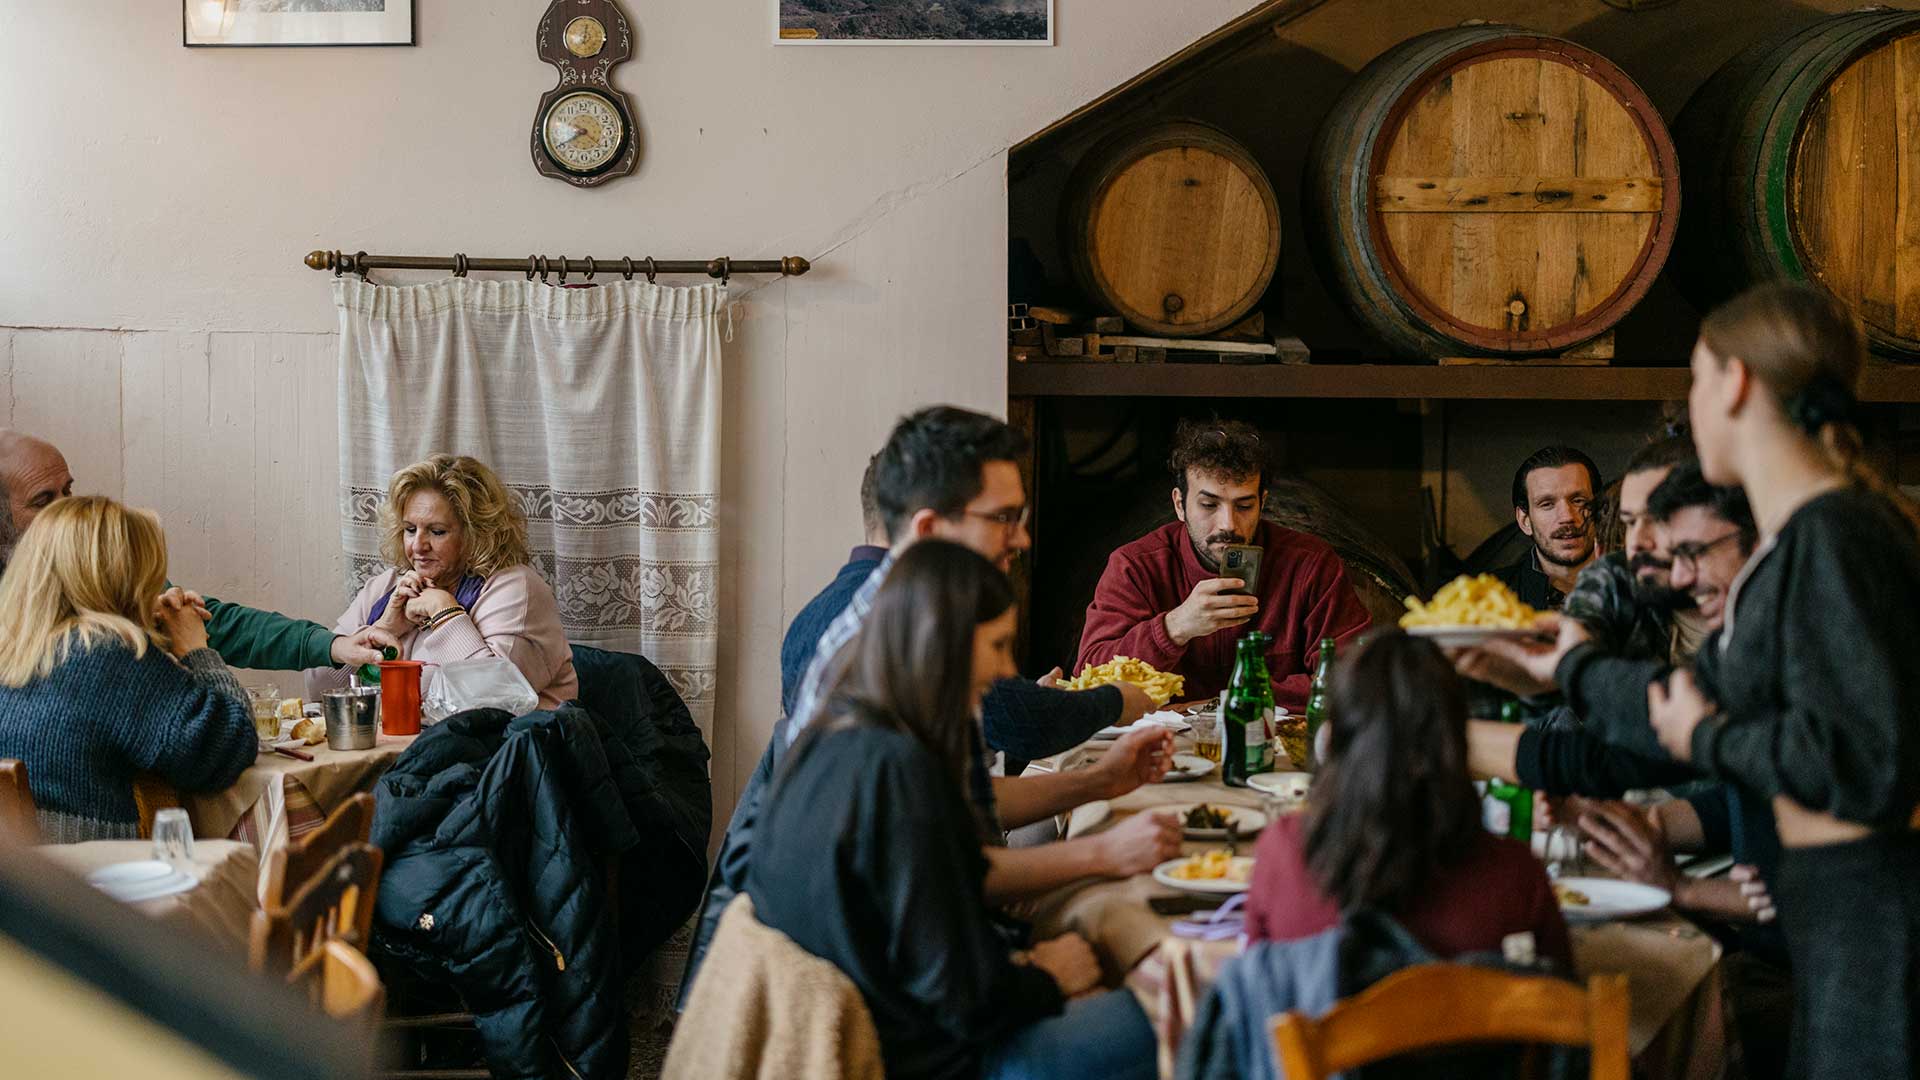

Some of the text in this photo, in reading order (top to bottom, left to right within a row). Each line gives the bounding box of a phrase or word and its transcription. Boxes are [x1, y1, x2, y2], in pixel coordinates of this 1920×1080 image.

[567, 106, 574, 115] 11
[601, 116, 609, 124] 2
[569, 150, 575, 158] 7
[580, 153, 588, 161] 6
